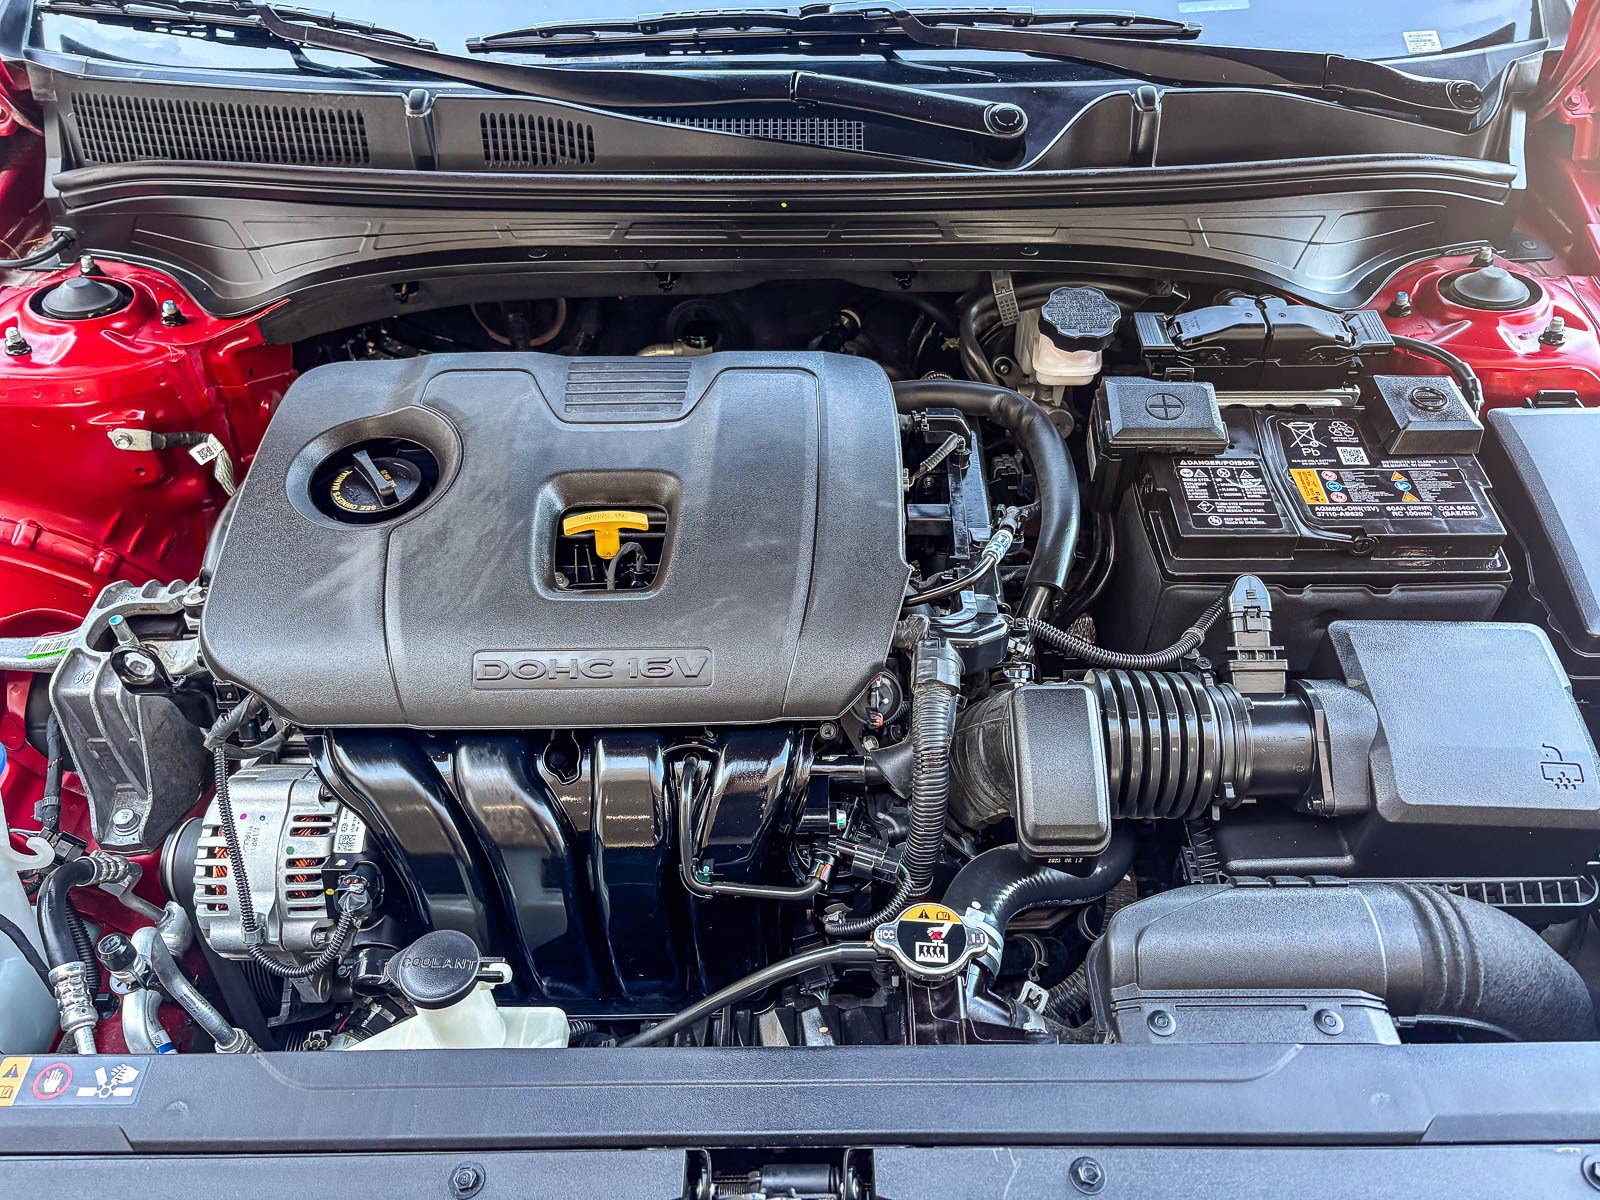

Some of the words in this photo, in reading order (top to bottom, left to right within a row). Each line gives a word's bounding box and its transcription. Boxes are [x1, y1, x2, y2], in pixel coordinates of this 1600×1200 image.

[1301, 447, 1321, 456] Pb
[331, 470, 353, 491] MANUAL
[476, 658, 614, 680] DOHC
[627, 656, 709, 679] 16V
[876, 929, 895, 940] HCC
[970, 933, 985, 944] 1.1
[401, 957, 478, 970] COOLANT
